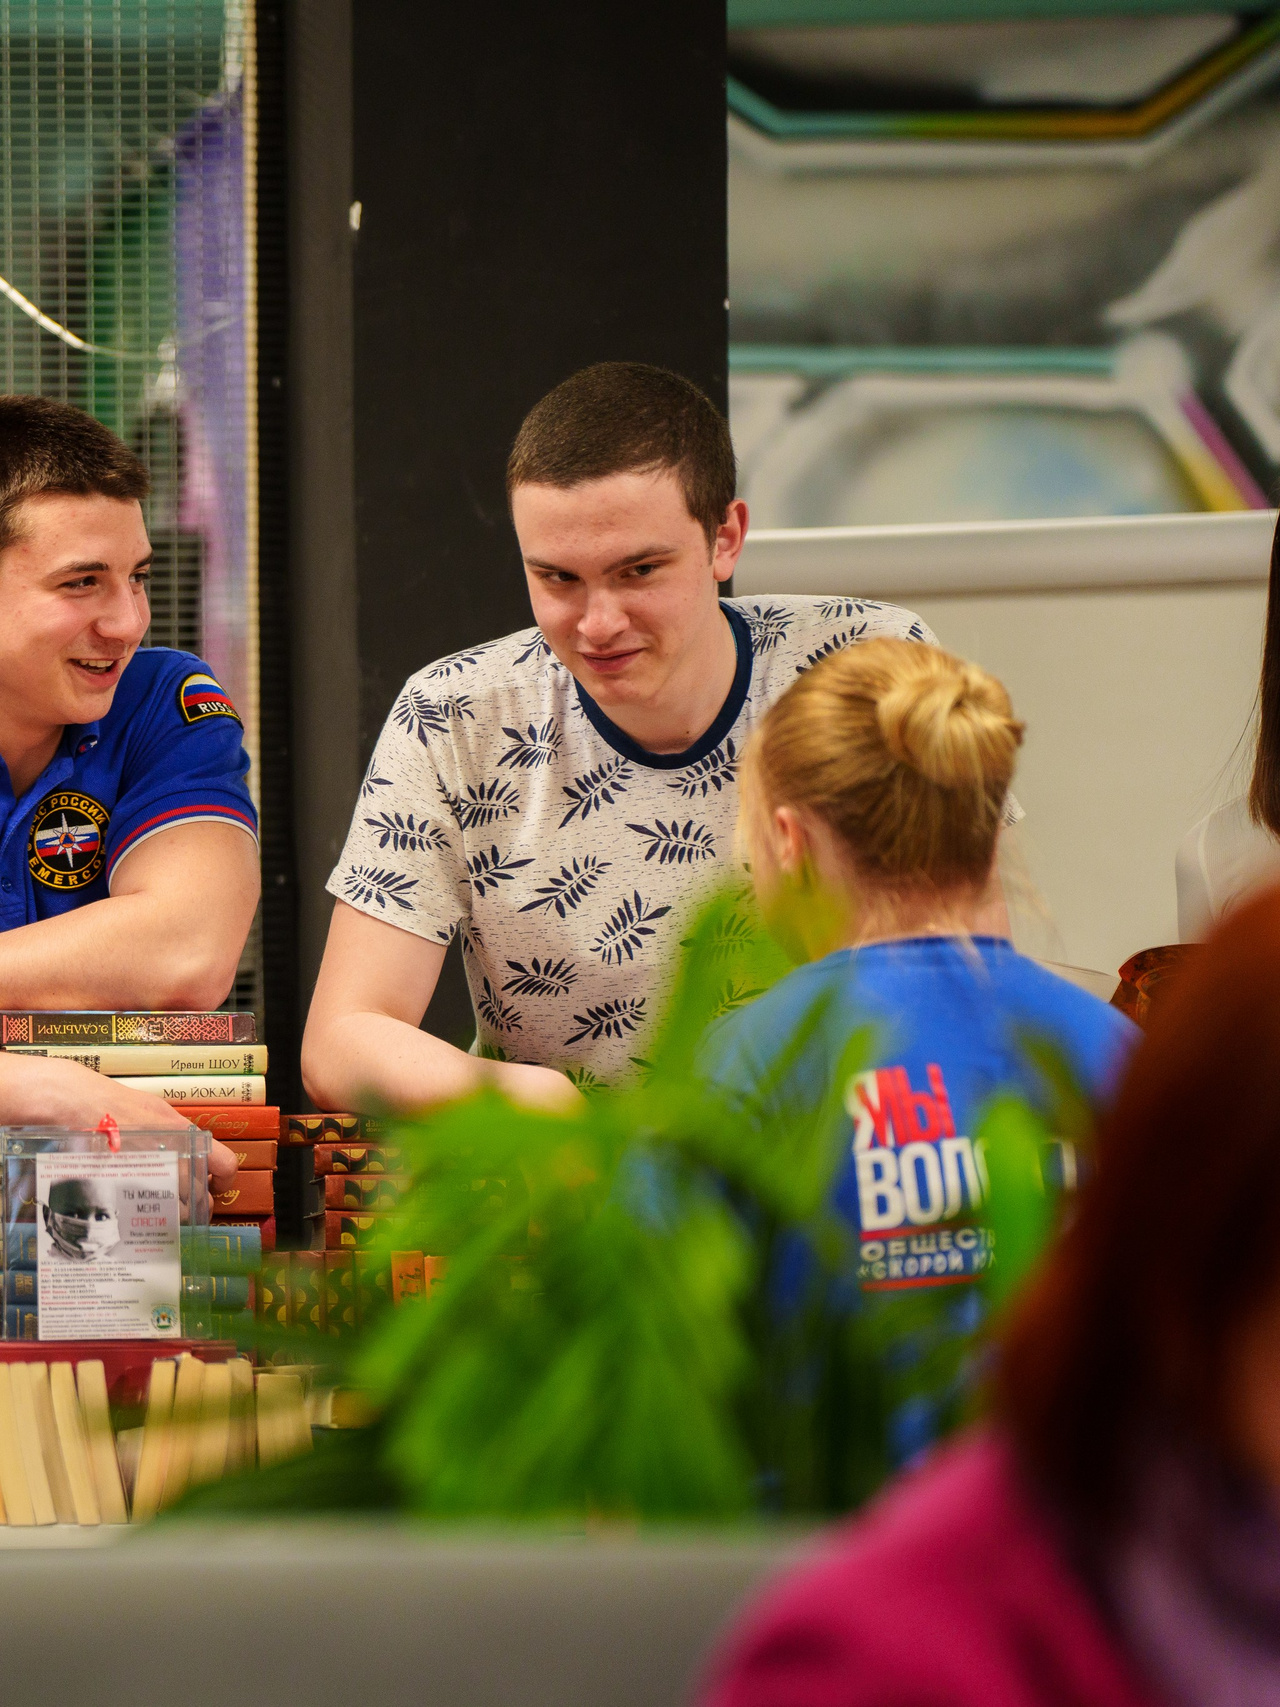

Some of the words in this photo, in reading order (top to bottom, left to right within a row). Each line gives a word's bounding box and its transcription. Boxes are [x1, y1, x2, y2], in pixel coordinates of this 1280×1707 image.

[50, 795, 106, 825] РОССИИ
[37, 1023, 109, 1036] Э.САЛЬГАРИ
[171, 1060, 205, 1072] Ирвин
[208, 1058, 241, 1070] ШОУ
[163, 1088, 187, 1101] Мор
[123, 1190, 135, 1200] ТЫ
[137, 1190, 175, 1200] МОЖЕШЬ
[137, 1203, 161, 1213] МЕНЯ
